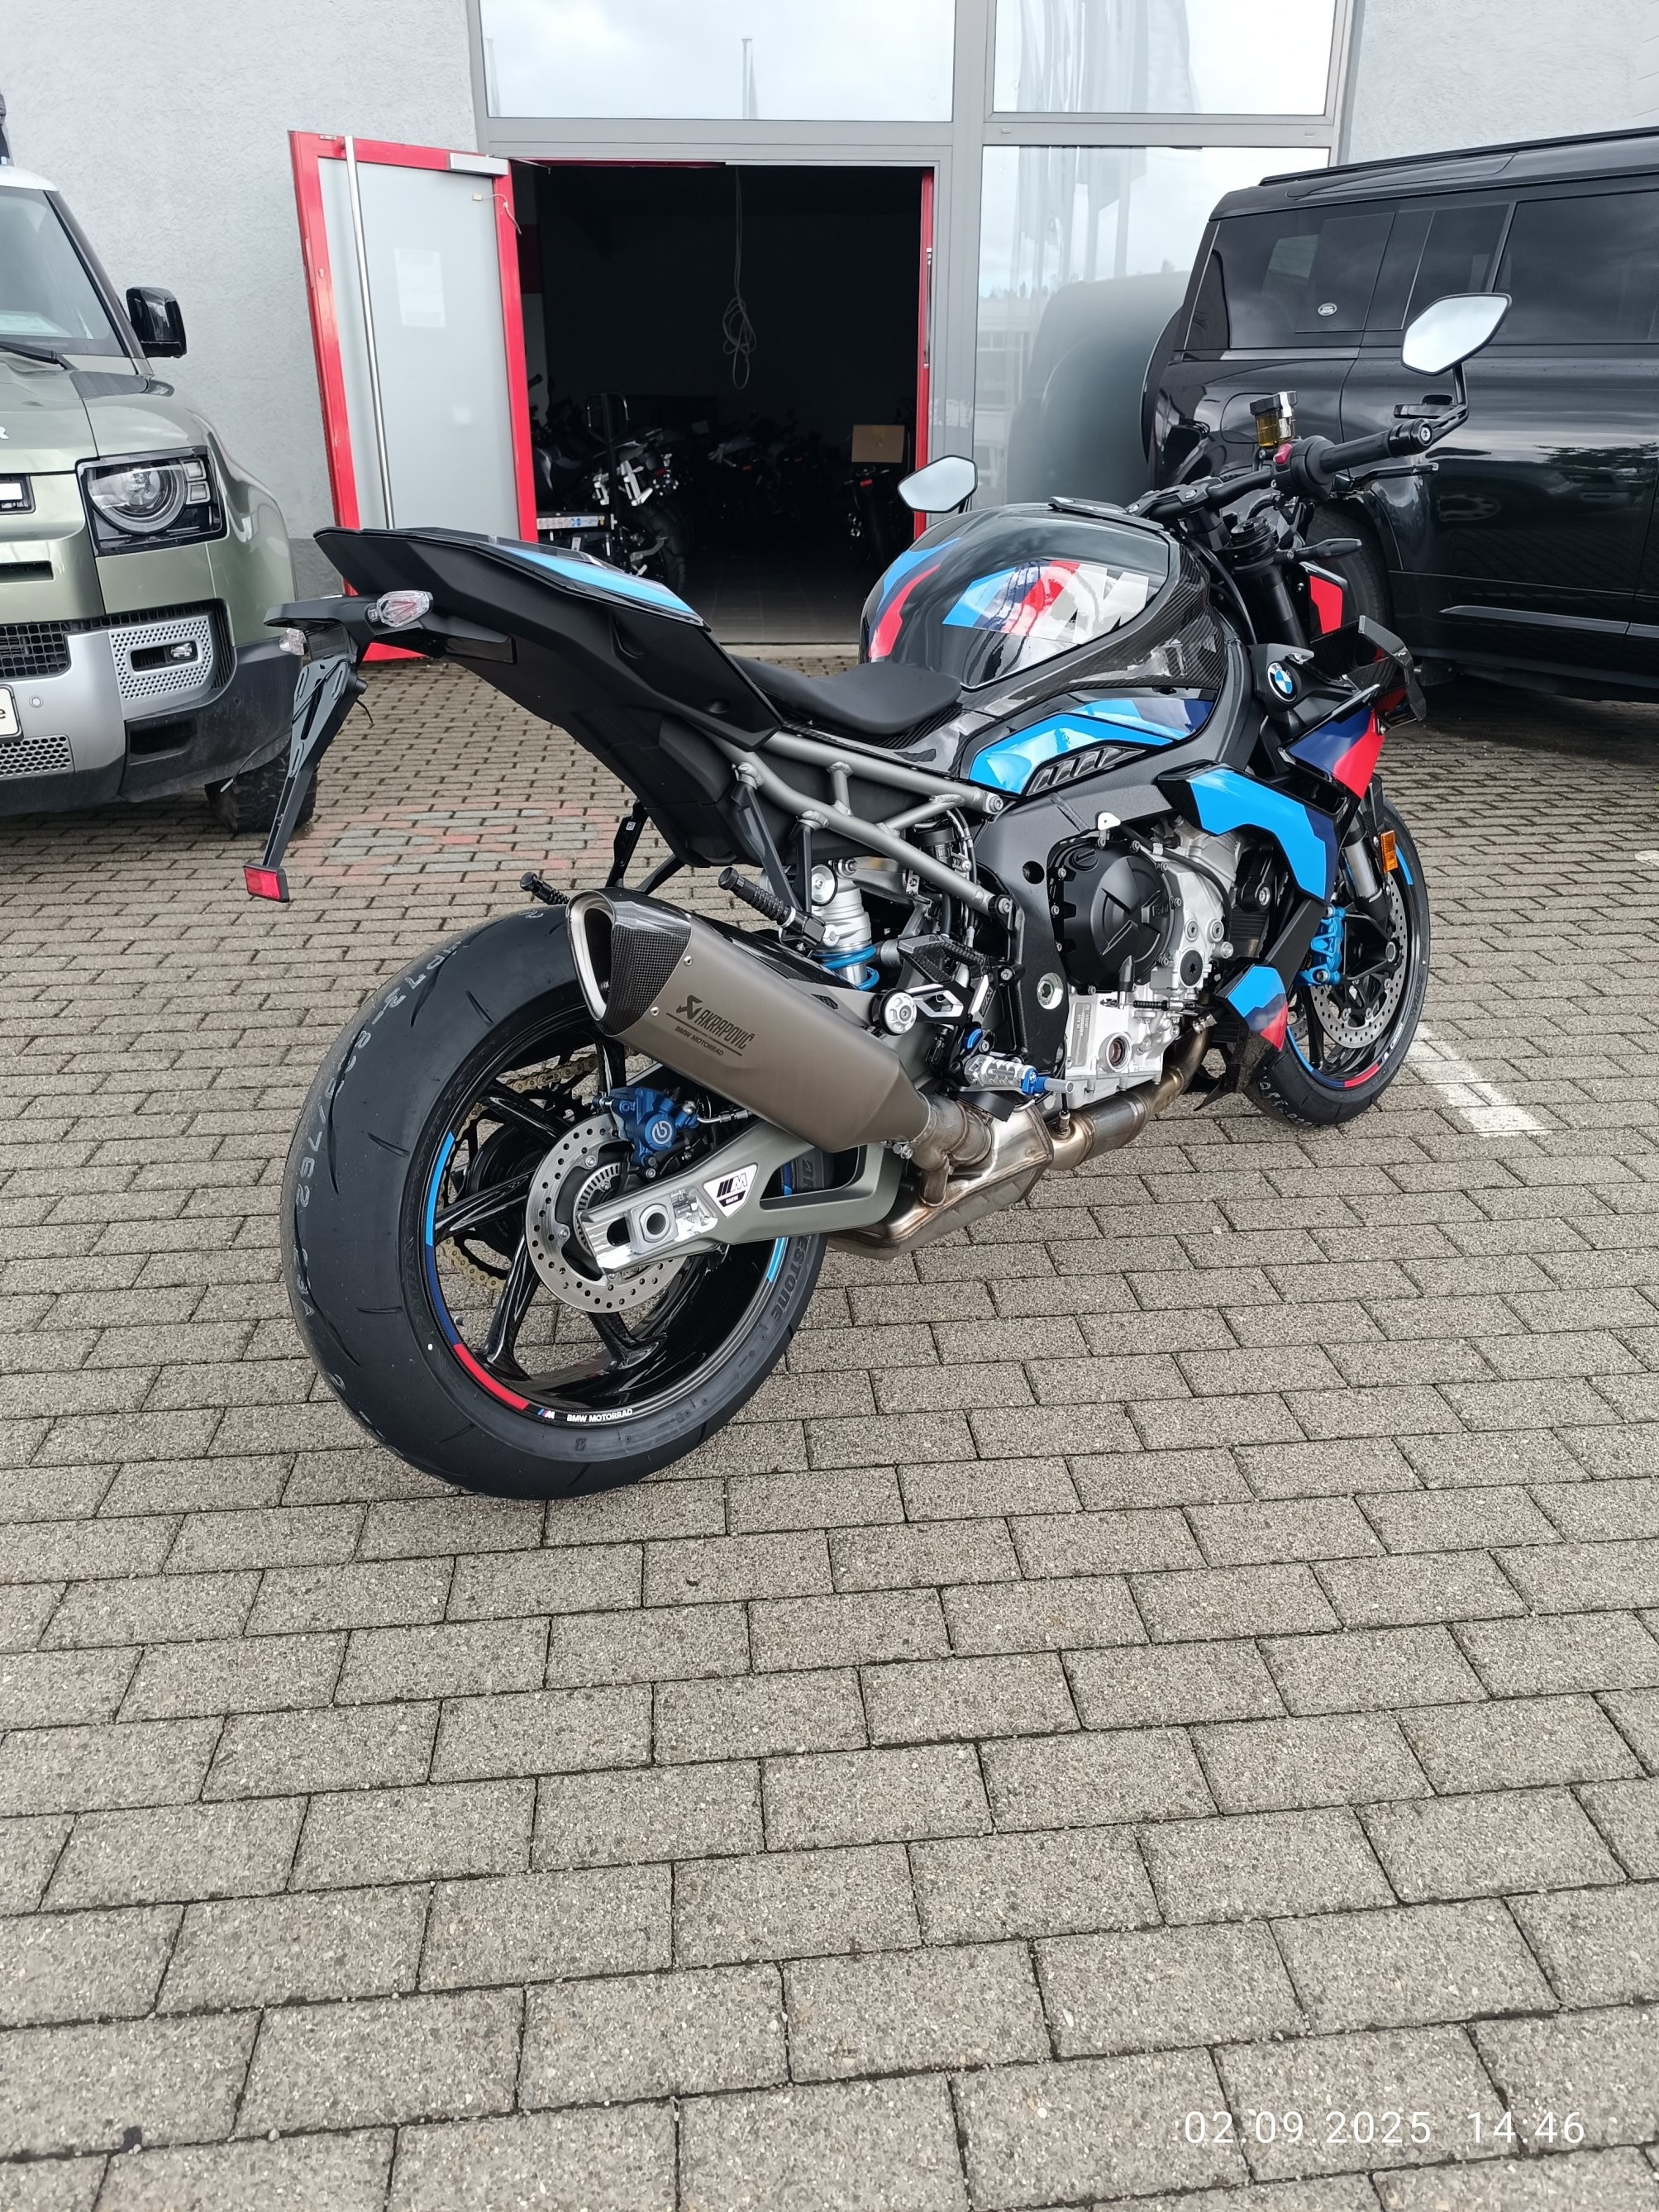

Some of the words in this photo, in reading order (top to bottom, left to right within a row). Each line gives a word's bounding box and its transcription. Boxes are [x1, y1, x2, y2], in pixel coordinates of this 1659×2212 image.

[675, 1026, 690, 1038] BMW
[690, 1035, 724, 1056] MOTORRAD
[694, 1008, 756, 1050] AKRAPOVIČ
[567, 1413, 587, 1423] BMW
[589, 1409, 633, 1423] MOTORRAD
